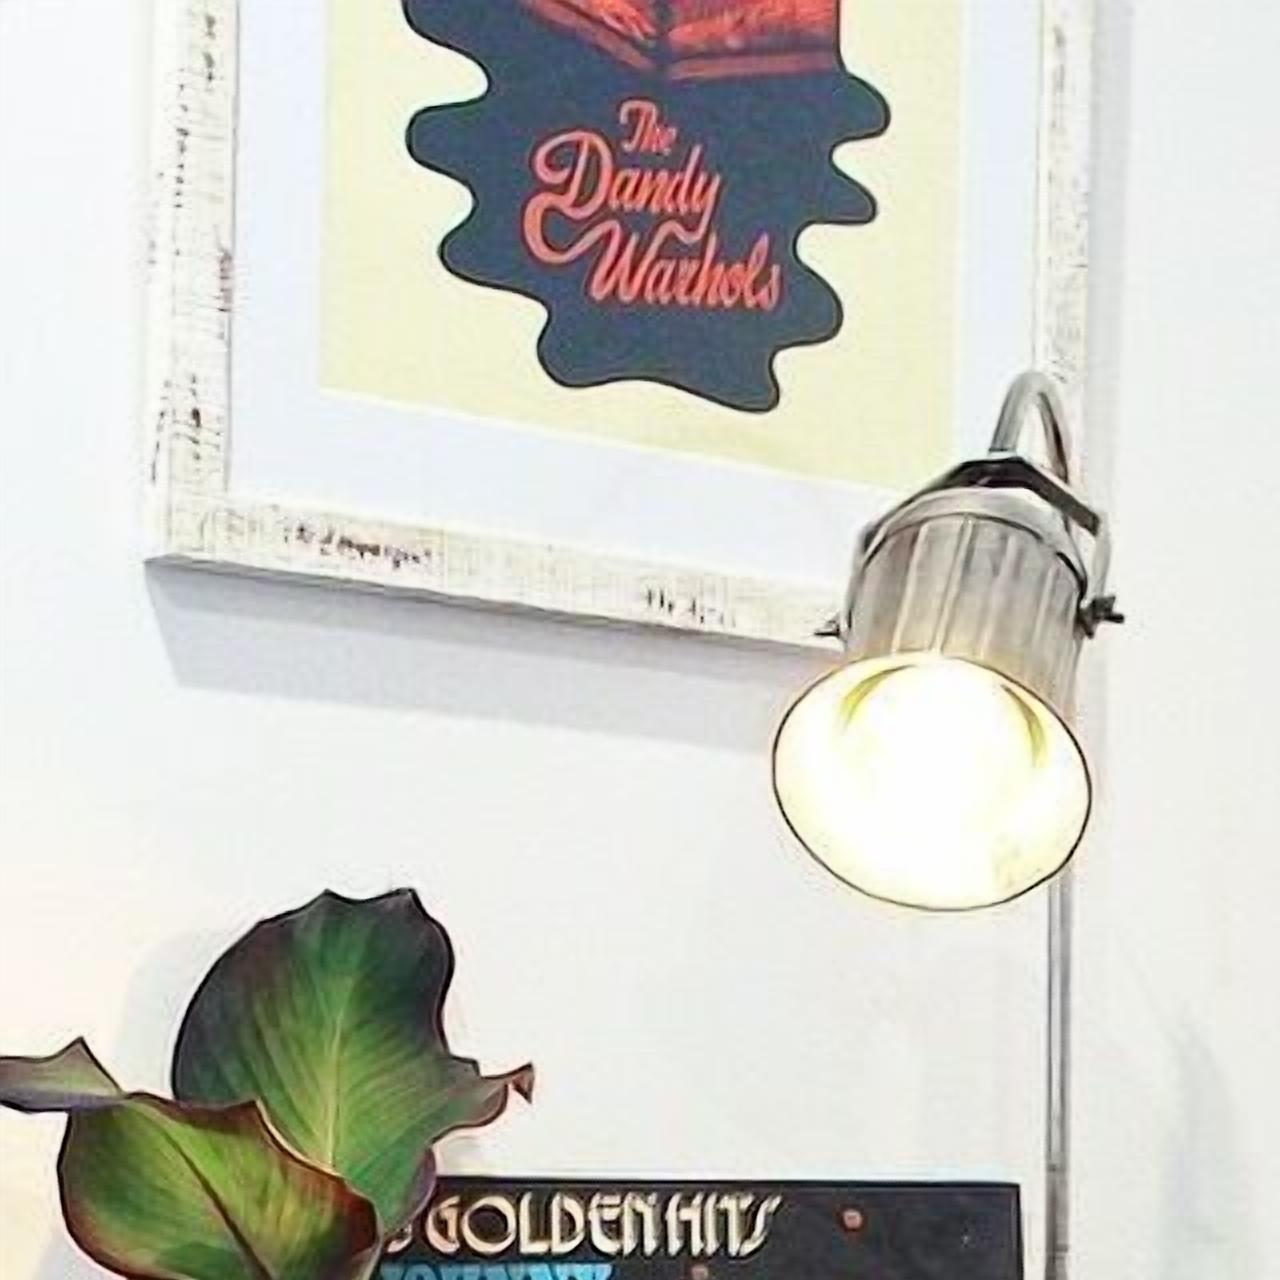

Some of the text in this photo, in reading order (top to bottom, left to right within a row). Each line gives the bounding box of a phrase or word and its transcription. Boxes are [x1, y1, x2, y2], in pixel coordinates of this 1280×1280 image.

[618, 99, 677, 156] The
[524, 129, 721, 246] Dandy
[588, 219, 781, 311] Warhols
[425, 1191, 658, 1257] GOLDEN
[665, 1191, 782, 1257] HITS
